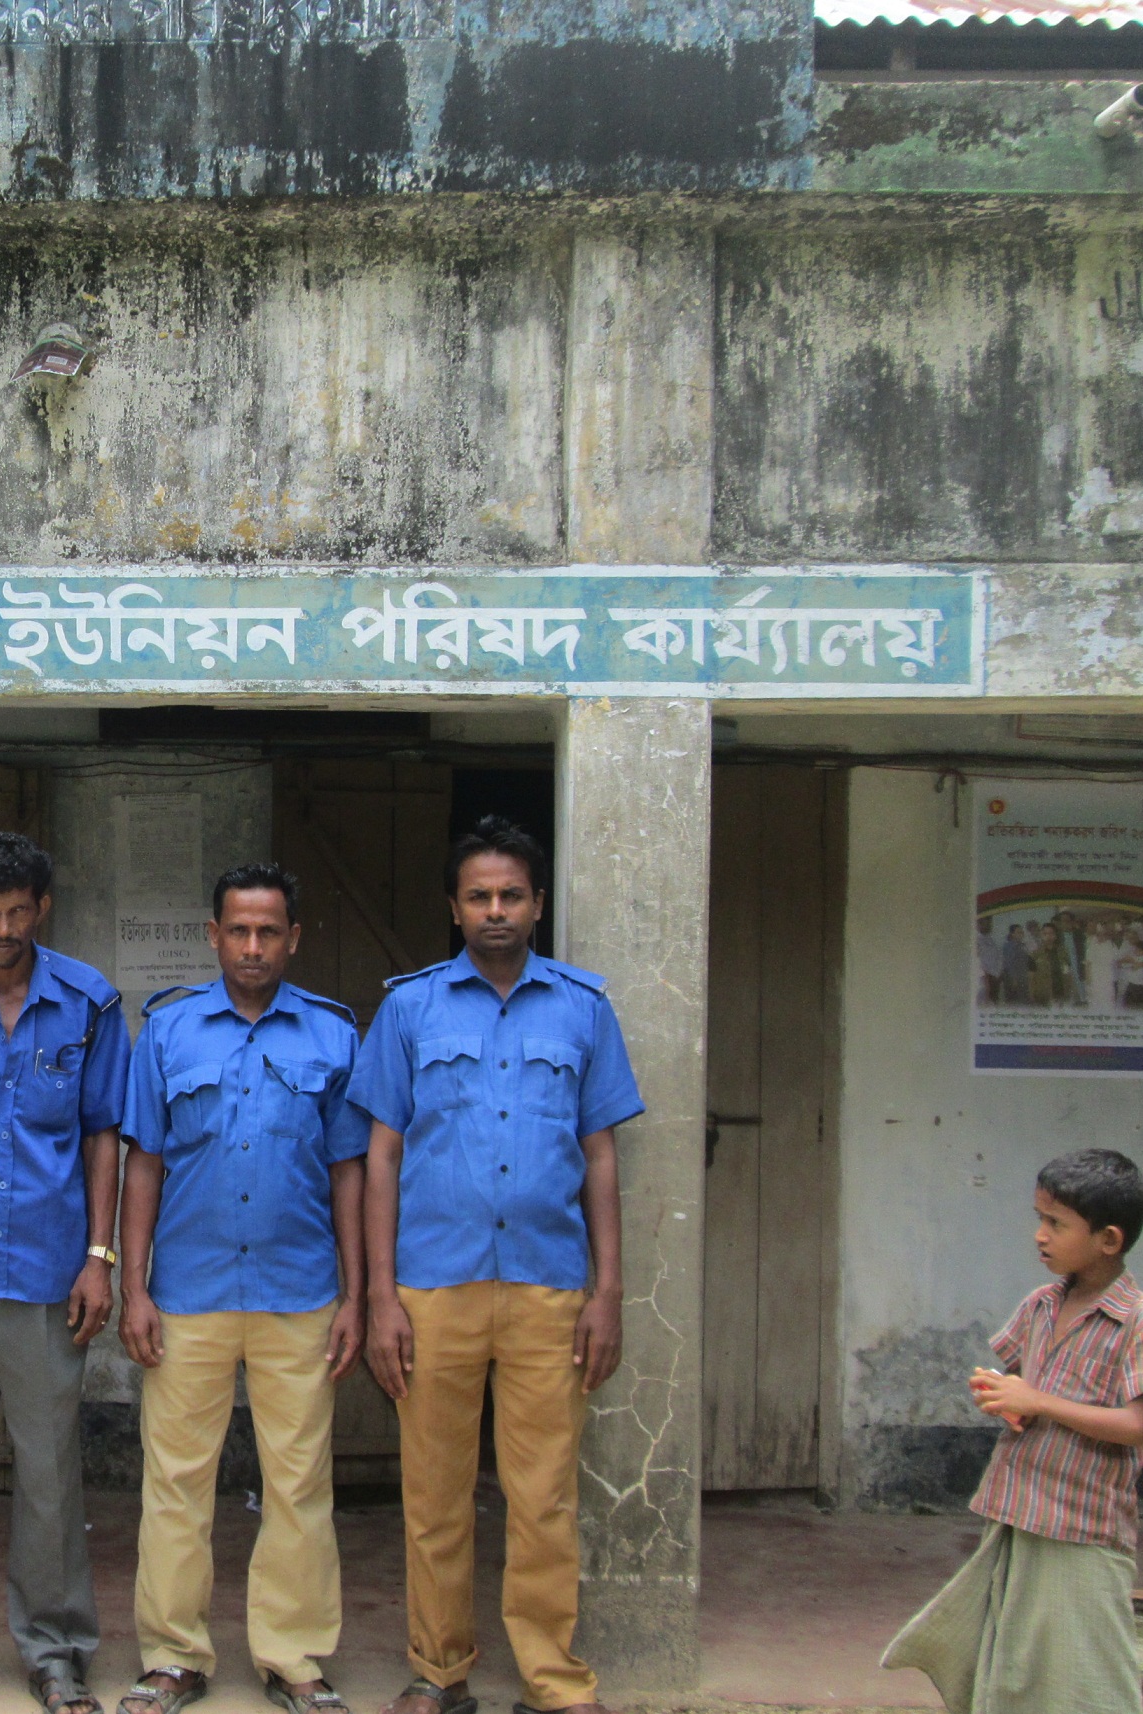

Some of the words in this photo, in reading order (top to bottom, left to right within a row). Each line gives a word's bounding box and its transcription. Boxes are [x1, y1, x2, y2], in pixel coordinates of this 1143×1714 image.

[342, 582, 587, 671] পরিষদ
[610, 586, 944, 678] কার্য্যালয়
[157, 950, 191, 959] (UISC)
